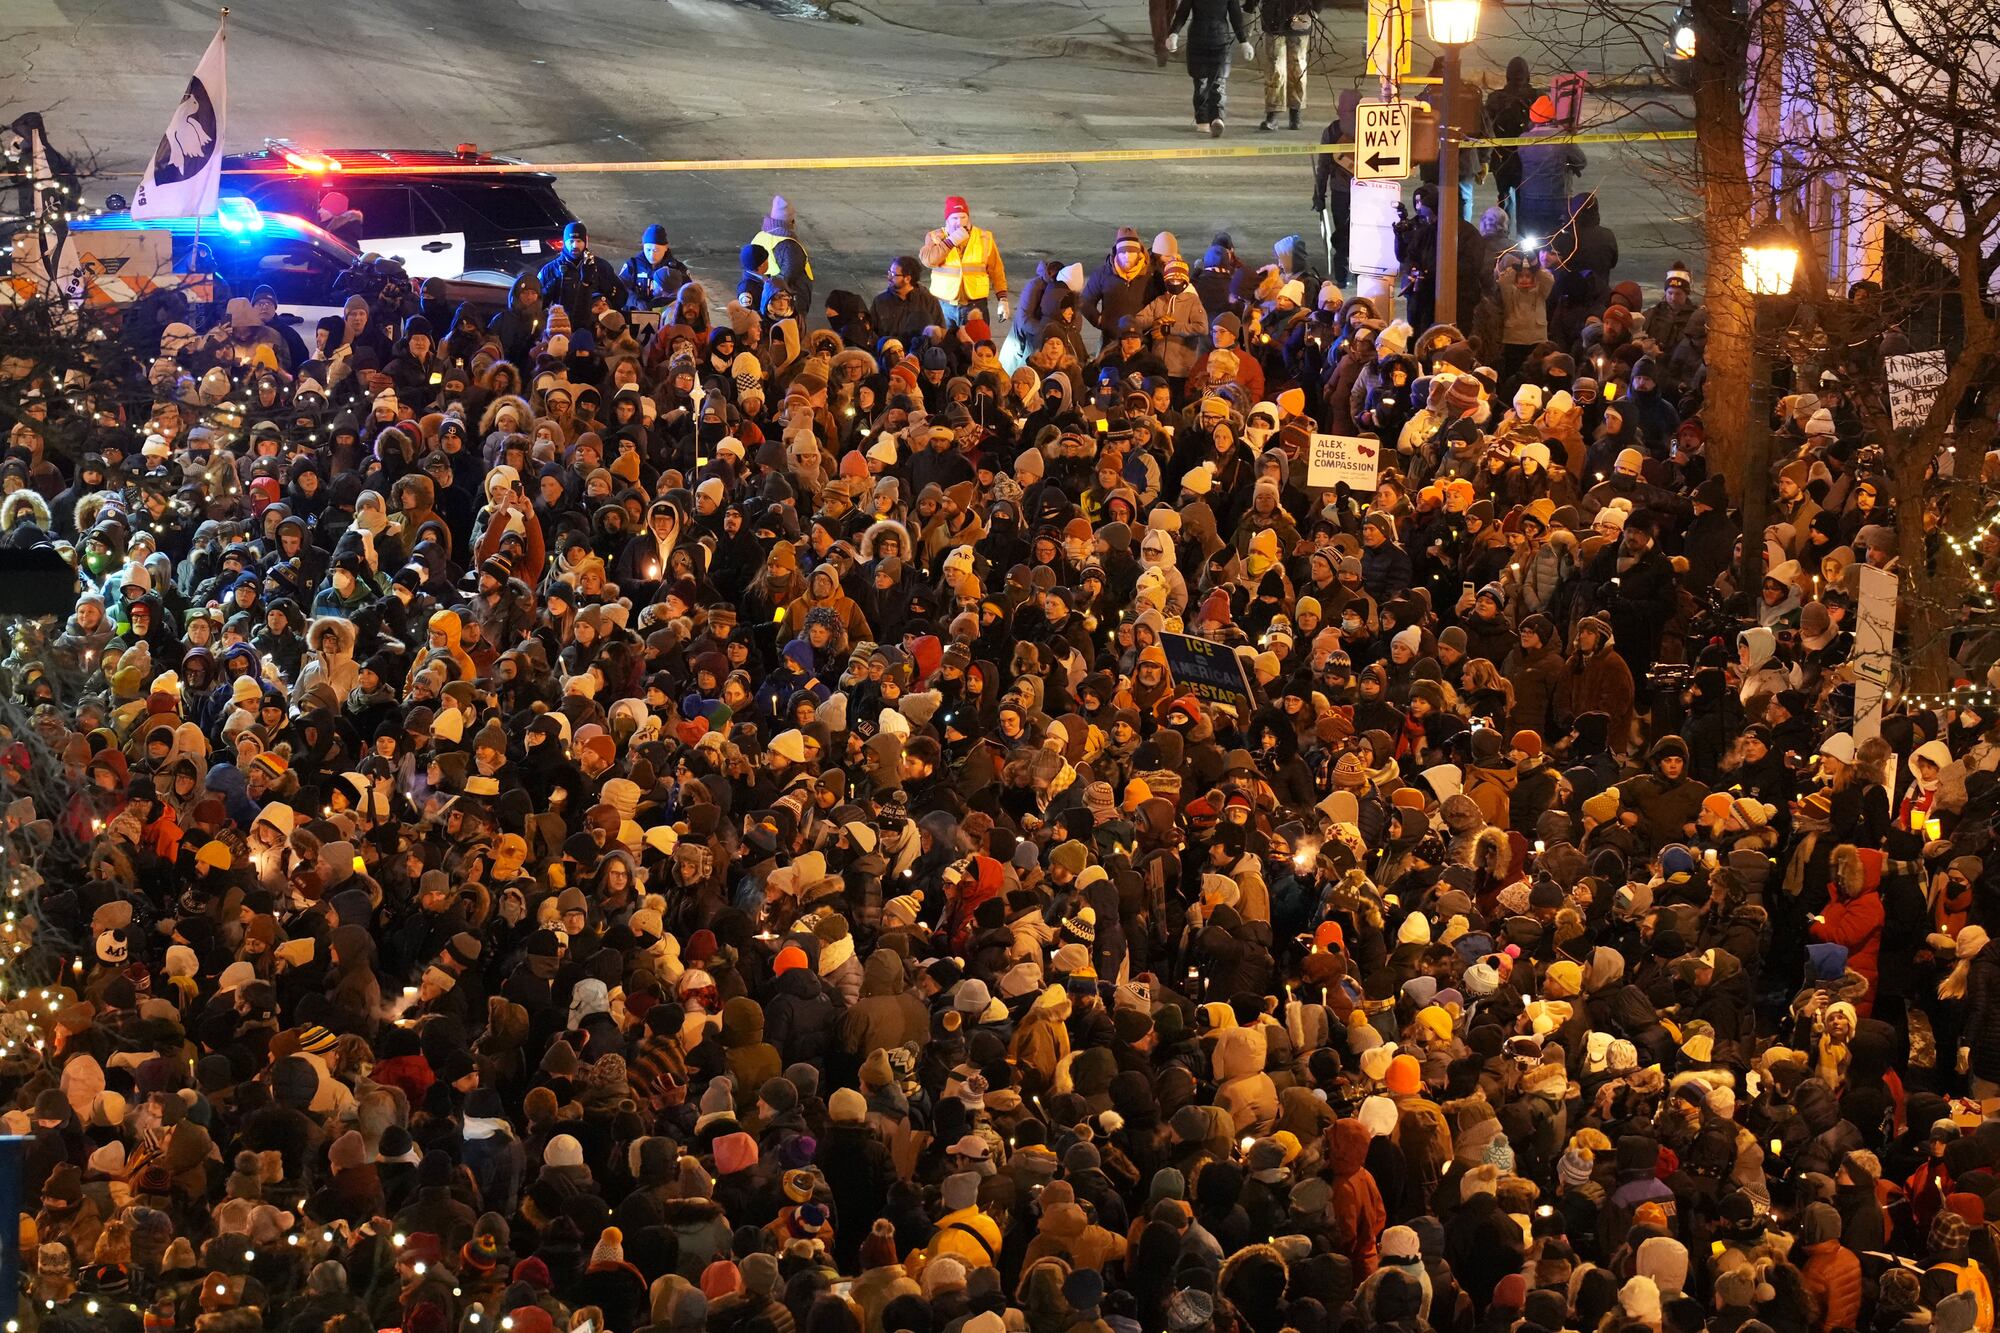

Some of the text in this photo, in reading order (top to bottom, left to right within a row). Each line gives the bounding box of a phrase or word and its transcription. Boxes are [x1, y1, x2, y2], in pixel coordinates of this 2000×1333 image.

[1367, 110, 1400, 126] ONE
[1365, 130, 1401, 147] WAY
[1318, 440, 1342, 449] ALEX
[1314, 459, 1374, 472] COMPASSION
[1185, 638, 1214, 657] ICE
